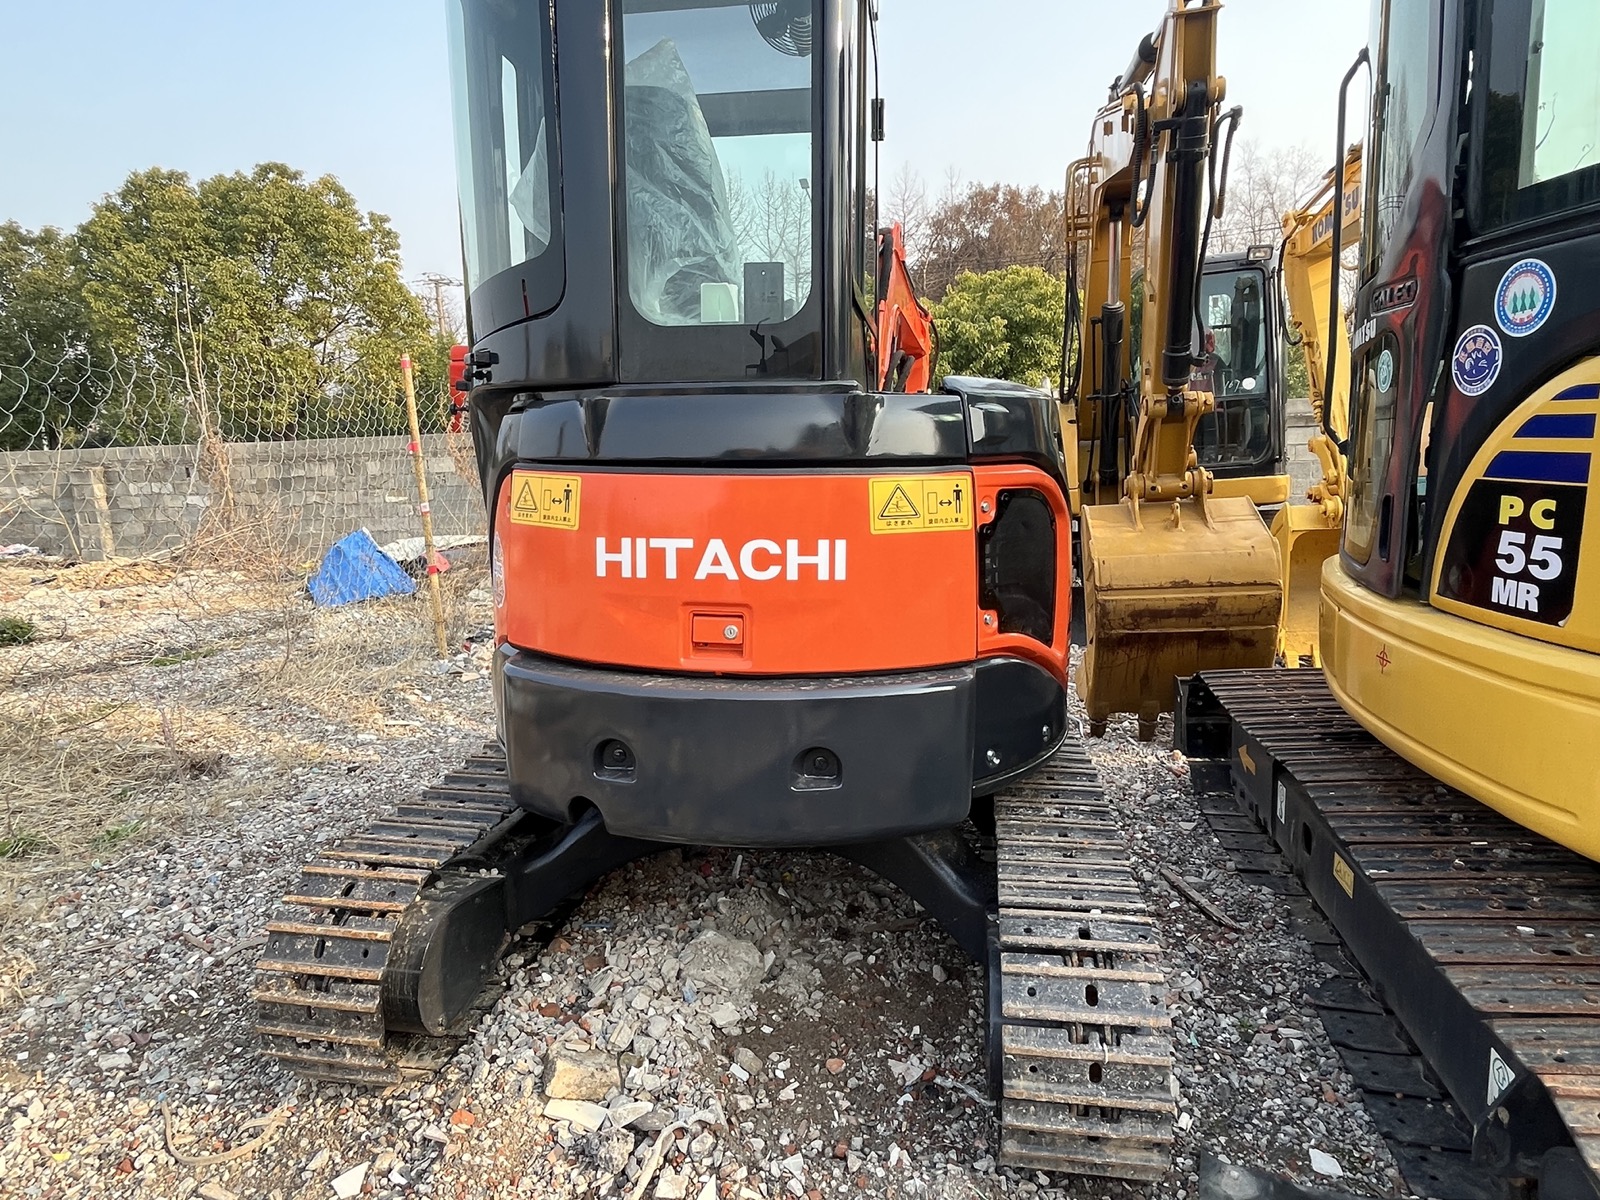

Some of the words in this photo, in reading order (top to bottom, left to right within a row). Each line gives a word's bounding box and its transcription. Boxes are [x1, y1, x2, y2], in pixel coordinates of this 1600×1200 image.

[1312, 186, 1359, 244] KOMSU
[595, 537, 847, 581] HITACHI
[1495, 529, 1563, 581] 55
[1491, 576, 1540, 613] MR
